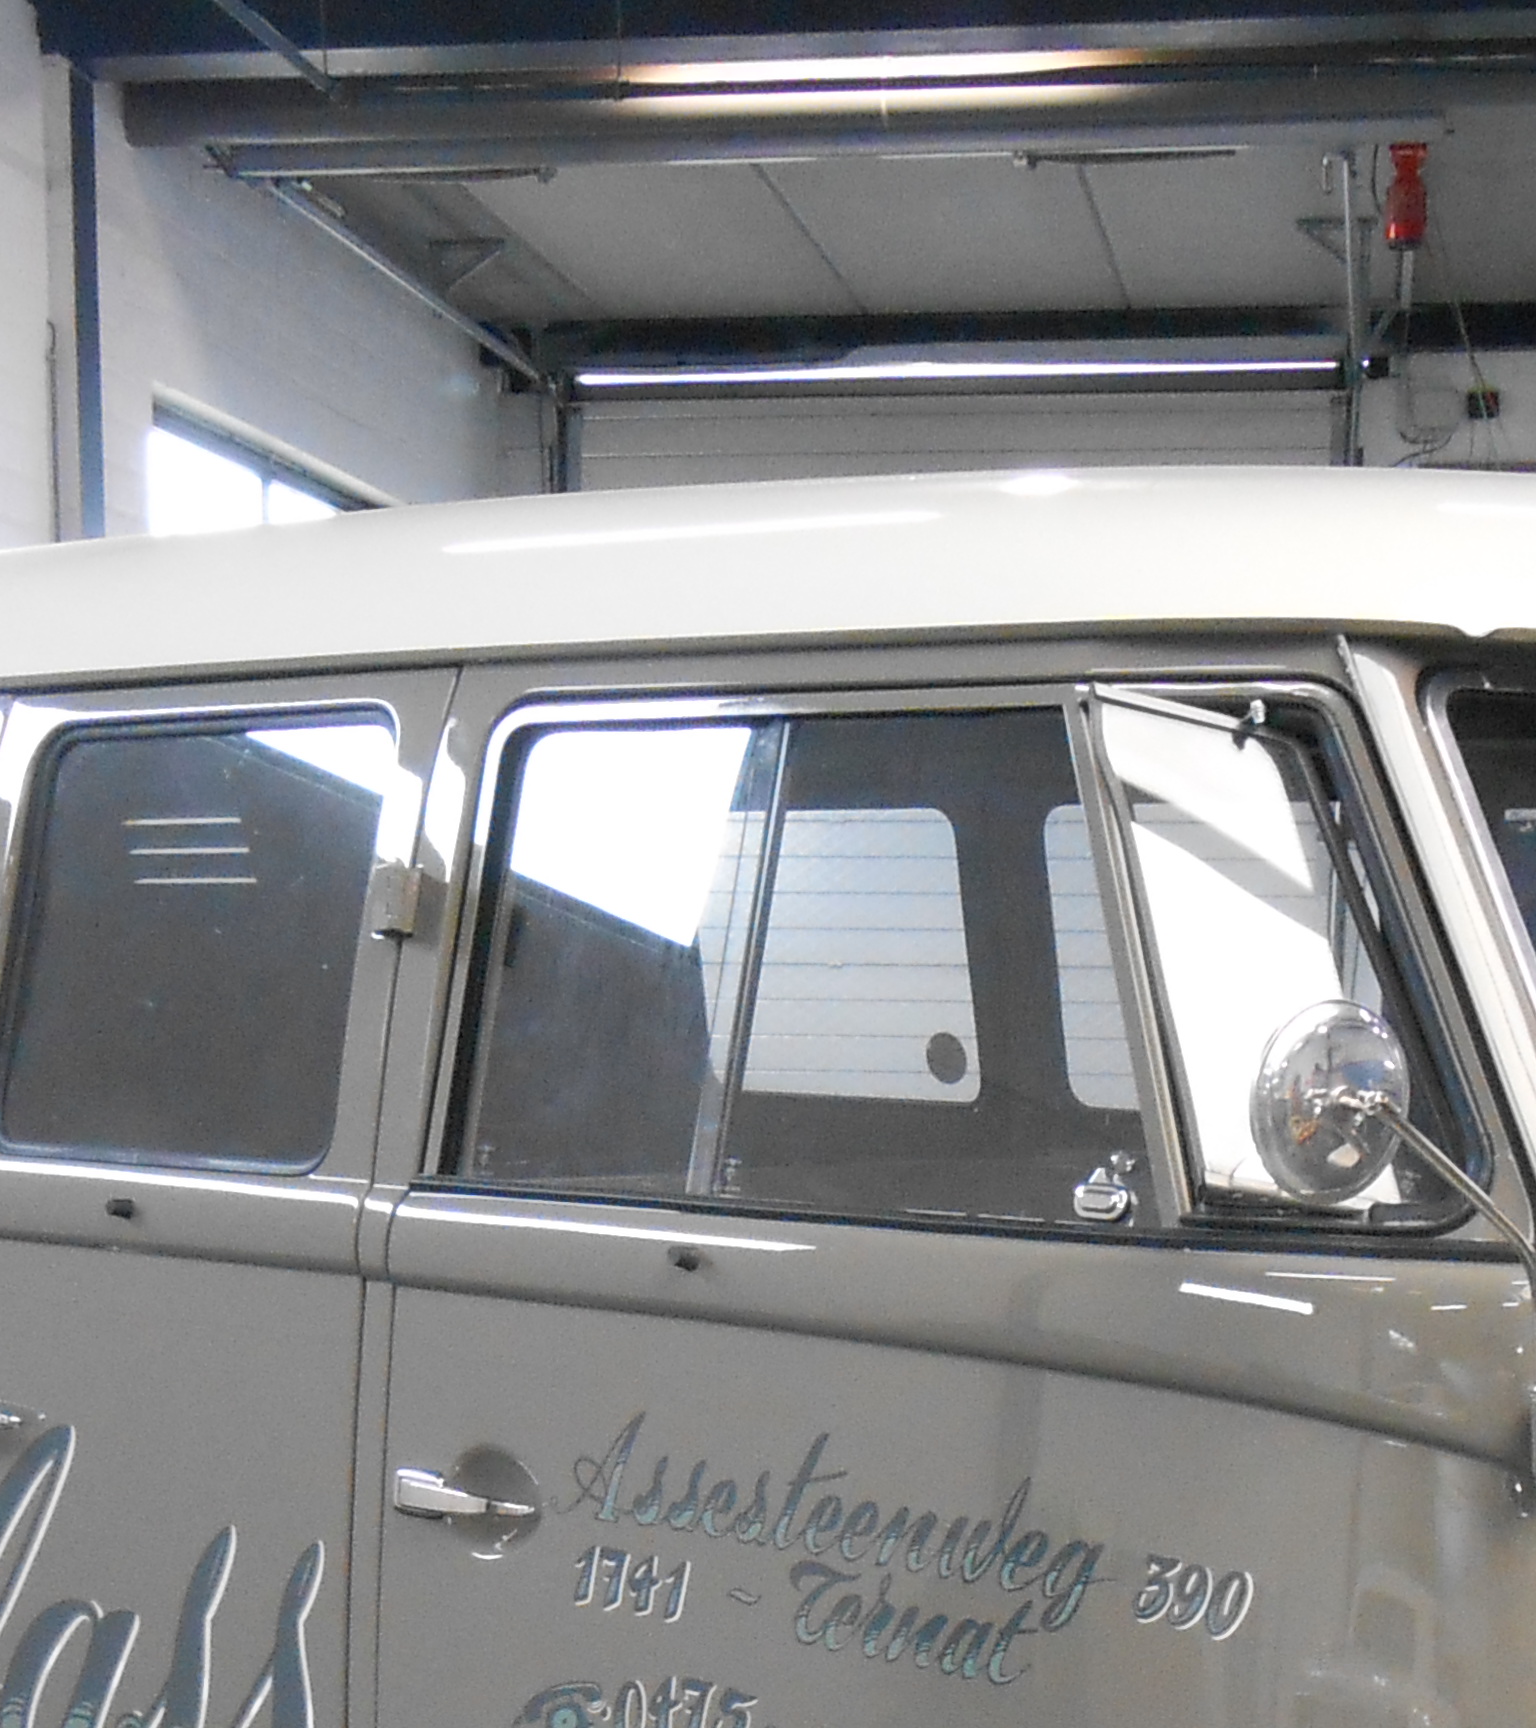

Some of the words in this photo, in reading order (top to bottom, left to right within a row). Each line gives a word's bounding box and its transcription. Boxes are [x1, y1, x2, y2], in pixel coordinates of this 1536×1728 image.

[552, 1410, 1118, 1632] Assesteenweg
[1131, 1552, 1255, 1641] 390
[574, 1545, 693, 1623] 1741
[789, 1559, 1040, 1685] Ternat
